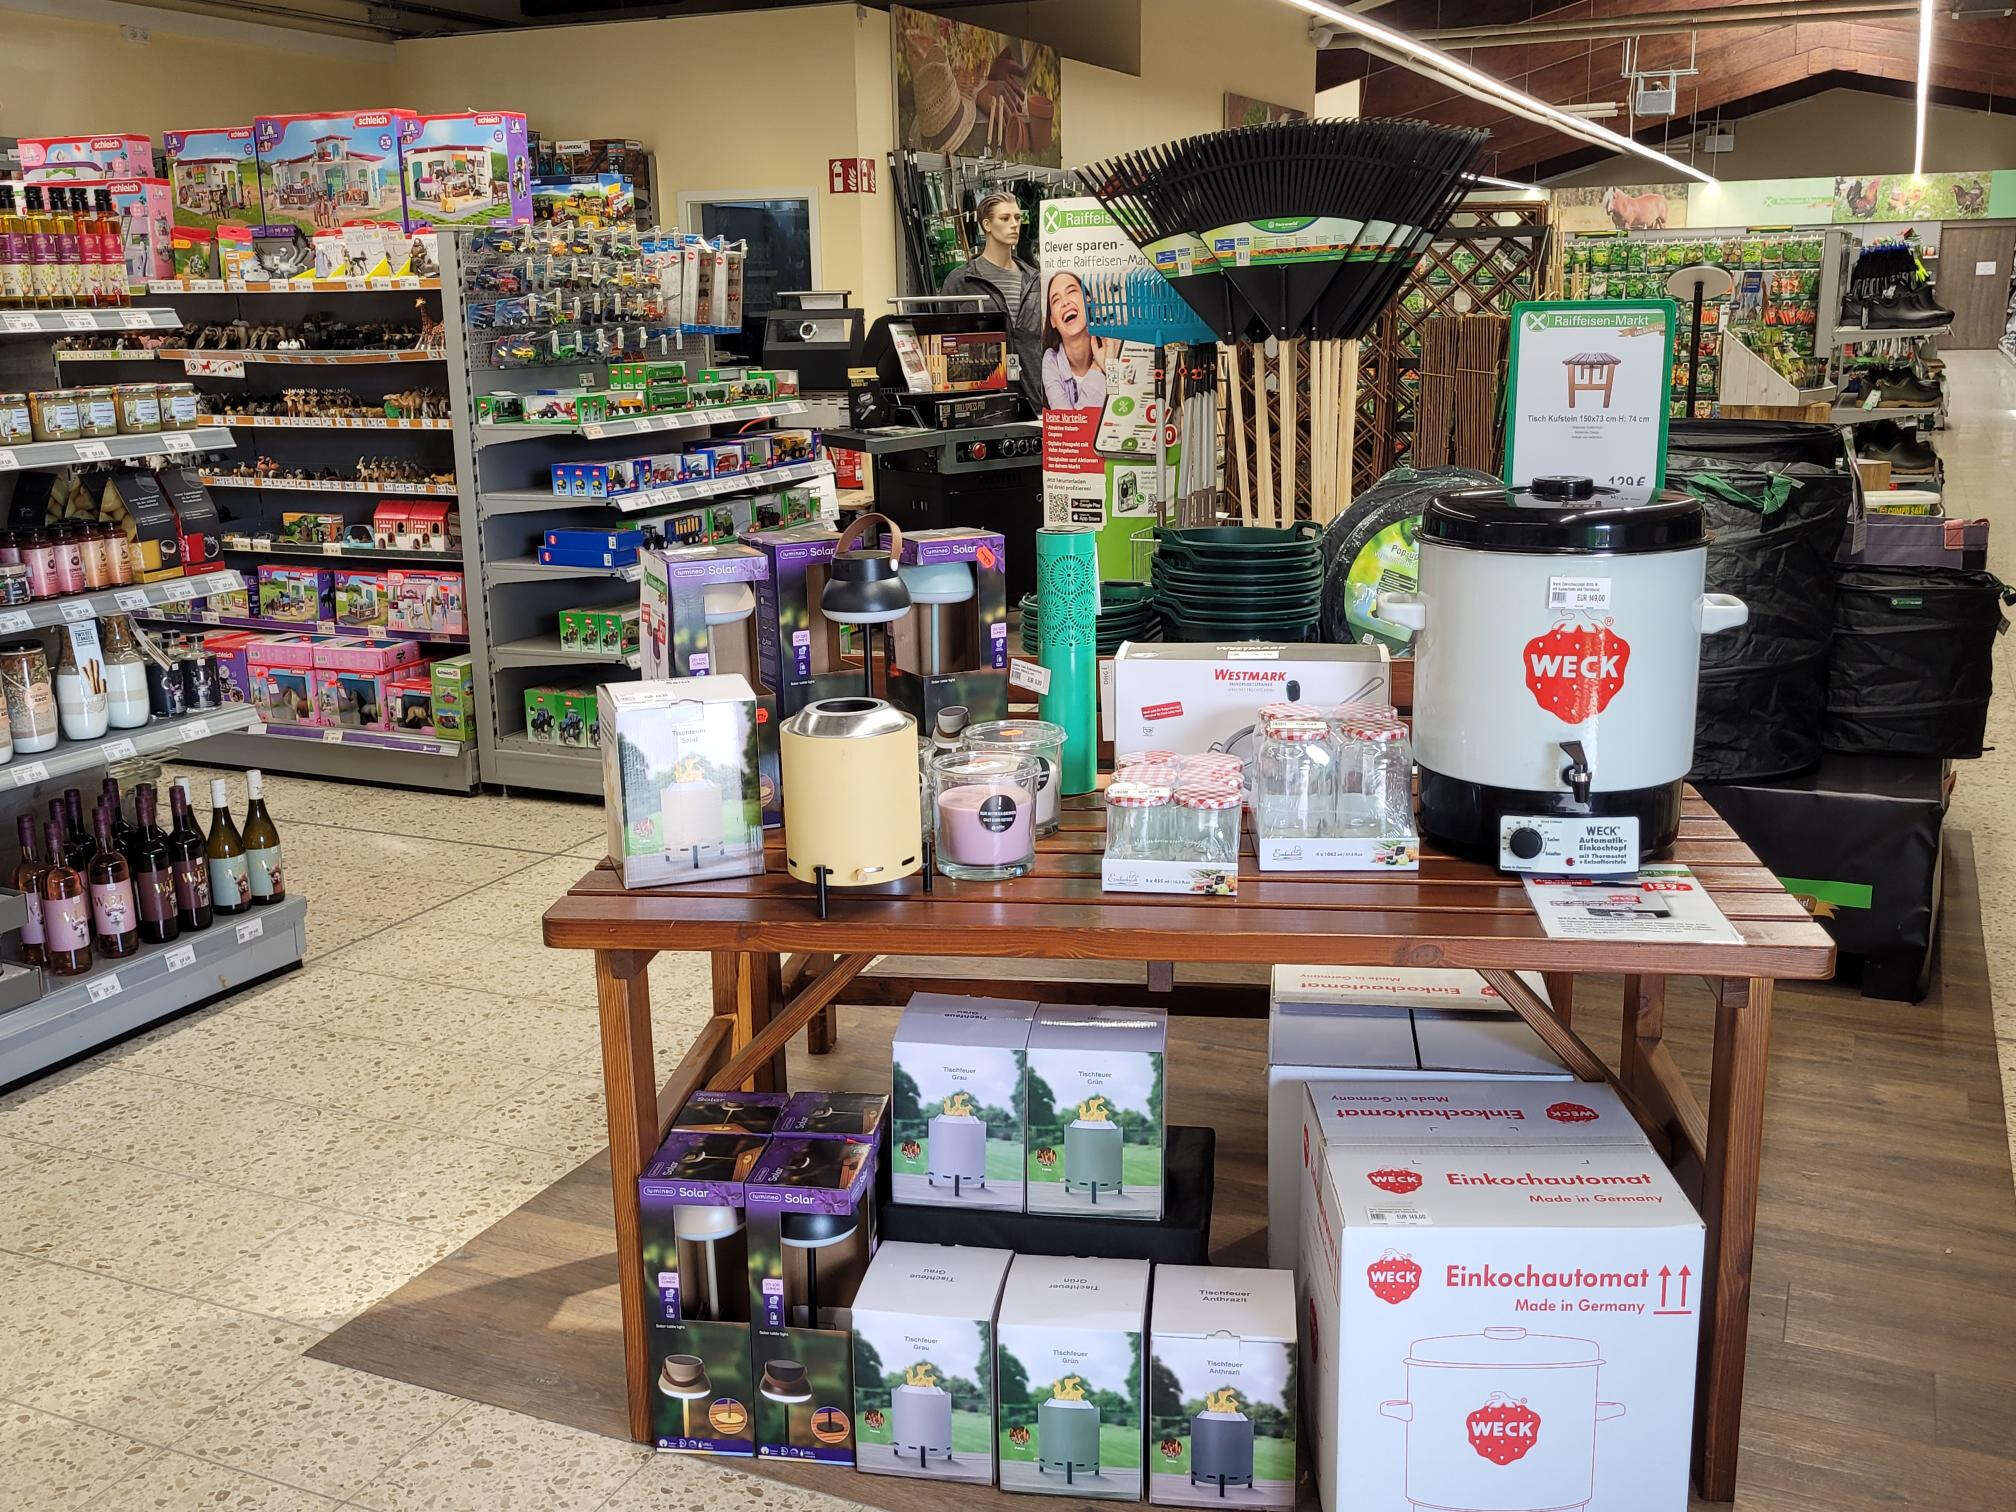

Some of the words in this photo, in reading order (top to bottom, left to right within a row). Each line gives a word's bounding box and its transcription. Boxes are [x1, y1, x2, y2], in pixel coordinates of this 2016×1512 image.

[358, 115, 388, 126] schleich
[477, 116, 500, 125] schleich
[93, 139, 120, 149] schleich
[110, 182, 138, 193] schleich
[1044, 240, 1073, 253] Clever
[1076, 240, 1118, 254] sparen
[1057, 257, 1070, 268] der
[1073, 253, 1151, 268] Raiffeisen-Mar
[1554, 314, 1649, 327] Raiffeisen-Markt
[1528, 415, 1547, 423] Tisch
[1548, 415, 1578, 423] Kufstein
[1580, 415, 1604, 423] 150x73
[1627, 415, 1637, 423] 74
[1887, 506, 1909, 516] COMPO
[810, 547, 836, 557] Solar
[952, 545, 978, 555] Solar
[708, 565, 738, 576] Solar
[1530, 654, 1620, 679] WECK
[1586, 826, 1617, 836] WECK
[1579, 844, 1627, 852] Einkochtopf
[1299, 973, 1352, 982] Germany
[1301, 982, 1461, 995] Einkochautomat
[943, 1066, 977, 1075] Tischfeuer
[1078, 1071, 1112, 1079] Tischfeuer
[951, 1073, 968, 1081] Grau
[1086, 1077, 1104, 1086] Grün
[1331, 1094, 1392, 1103] Germany
[1393, 1095, 1408, 1103] in
[1410, 1095, 1449, 1103] Made
[1336, 1108, 1526, 1120] Einkochautomat
[1550, 1109, 1597, 1118] WECK
[662, 1161, 679, 1176] Solar
[767, 1167, 784, 1182] Solar
[1371, 1175, 1419, 1184] WECK
[1446, 1172, 1652, 1186] Einkochautomat
[646, 1188, 674, 1196] lumineo
[679, 1187, 710, 1199] Solar
[752, 1193, 780, 1202] lumineo
[785, 1193, 816, 1206] Solar
[1528, 1194, 1572, 1203] Made
[1576, 1194, 1590, 1203] in
[1593, 1194, 1663, 1205] Germany
[1371, 1270, 1417, 1284] WECK
[1446, 1264, 1650, 1289] Einkochautomat
[1515, 1299, 1557, 1312] Made
[1561, 1299, 1574, 1312] in
[1578, 1299, 1645, 1314] Germany
[904, 1335, 939, 1344] Tischfeuer
[913, 1343, 930, 1351] Grau
[1053, 1350, 1088, 1358] Tischfeuer
[1206, 1360, 1244, 1368] Tischfeuer
[1209, 1368, 1241, 1376] Anthrazit
[1471, 1421, 1535, 1438] WECK
